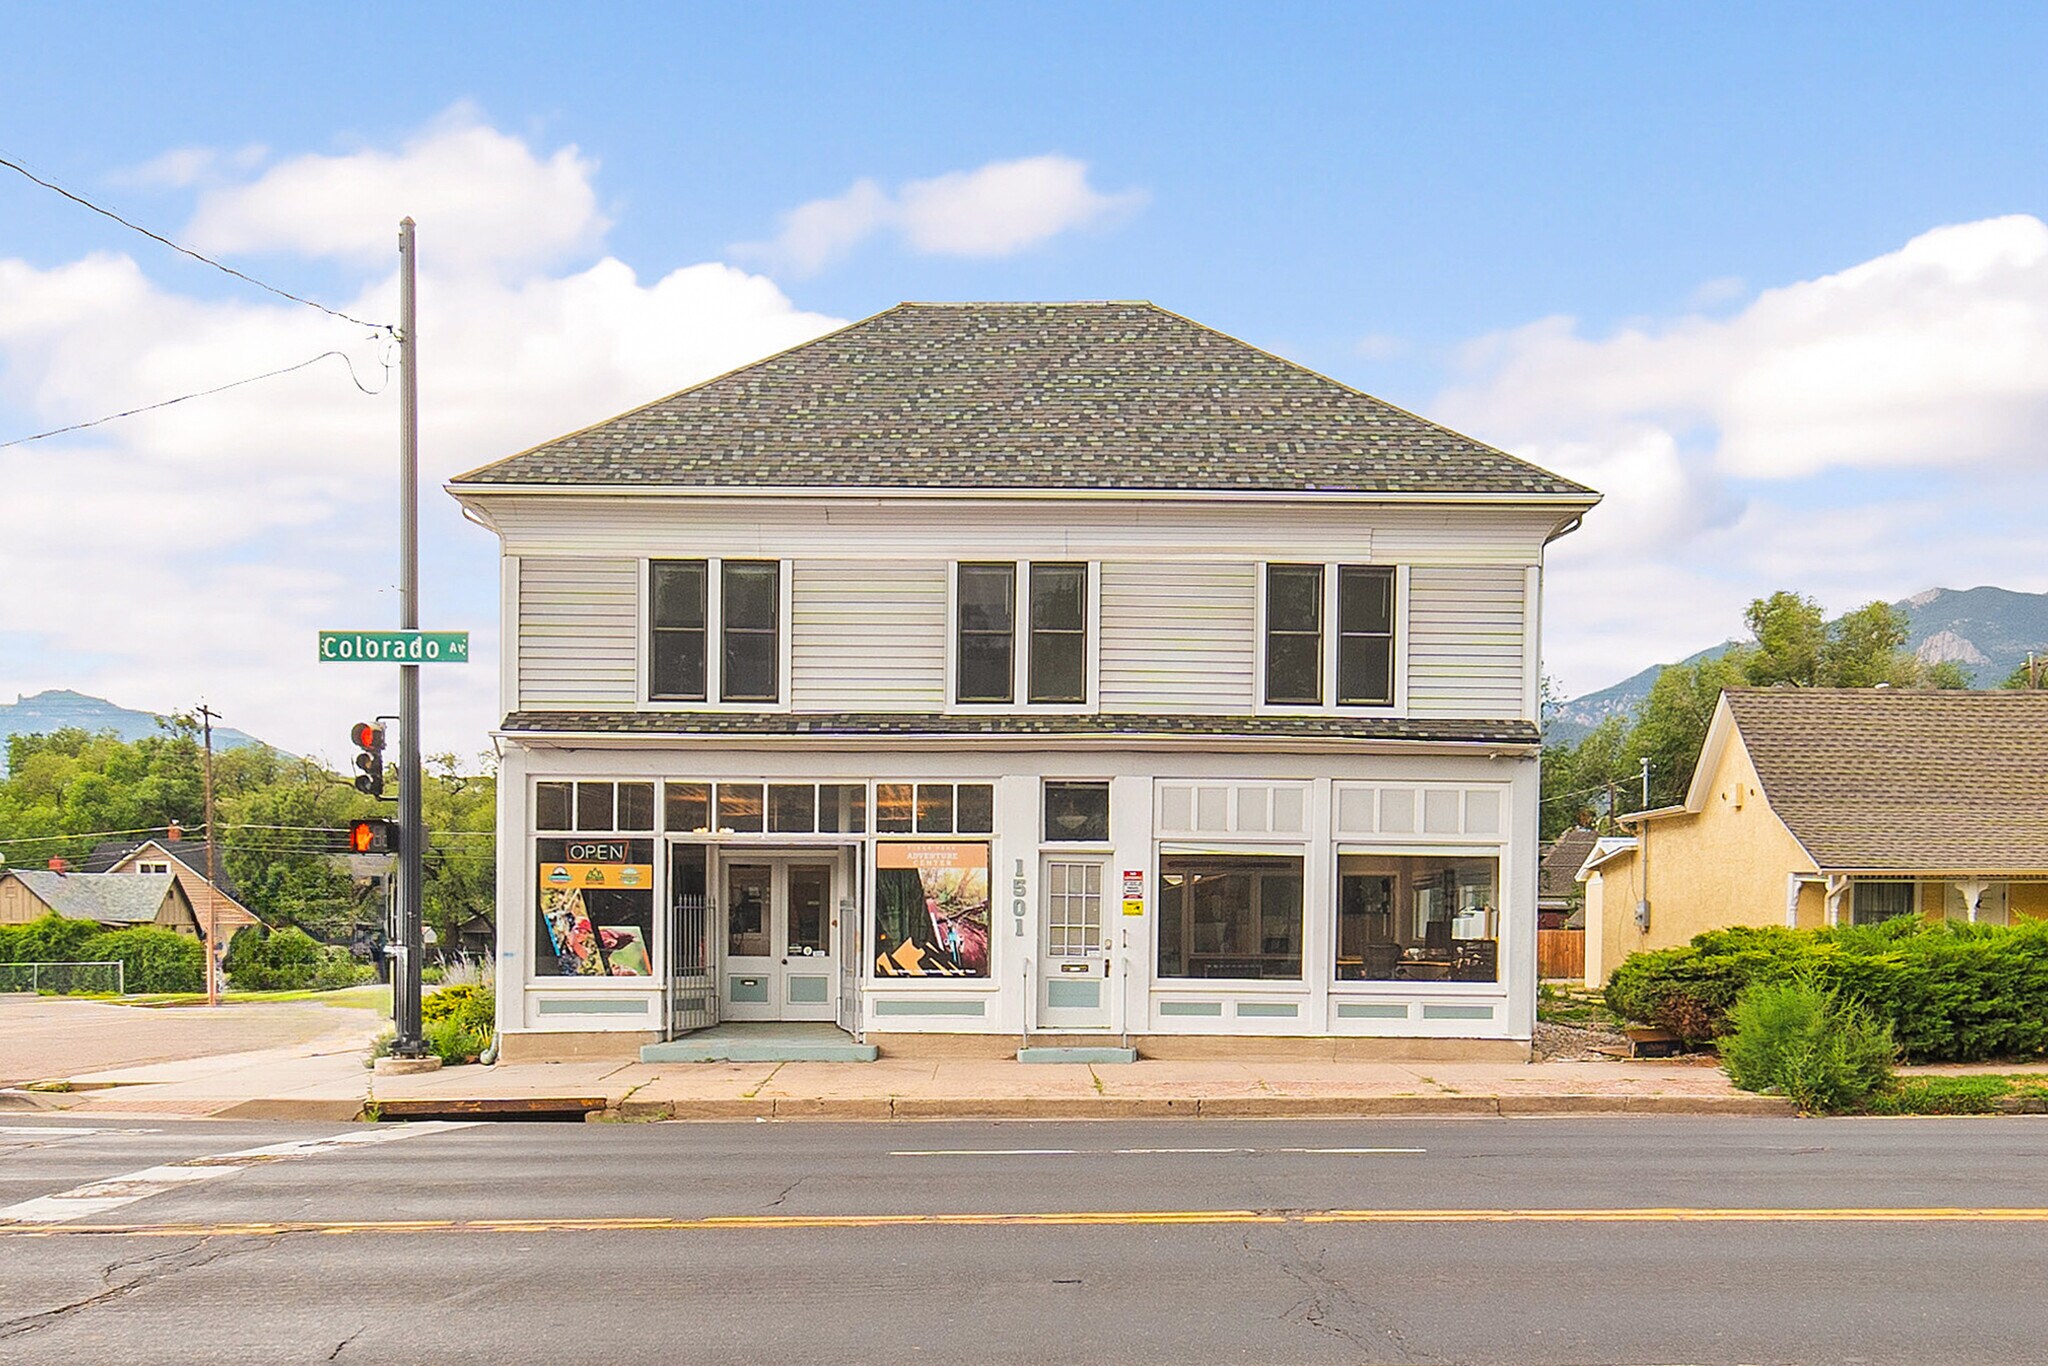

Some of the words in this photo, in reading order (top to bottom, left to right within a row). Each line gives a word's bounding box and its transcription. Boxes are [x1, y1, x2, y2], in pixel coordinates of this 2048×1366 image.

[324, 635, 440, 658] Colorado
[570, 844, 623, 860] OPEN
[907, 852, 959, 860] ADVENTURE
[1012, 859, 1026, 937] 1501
